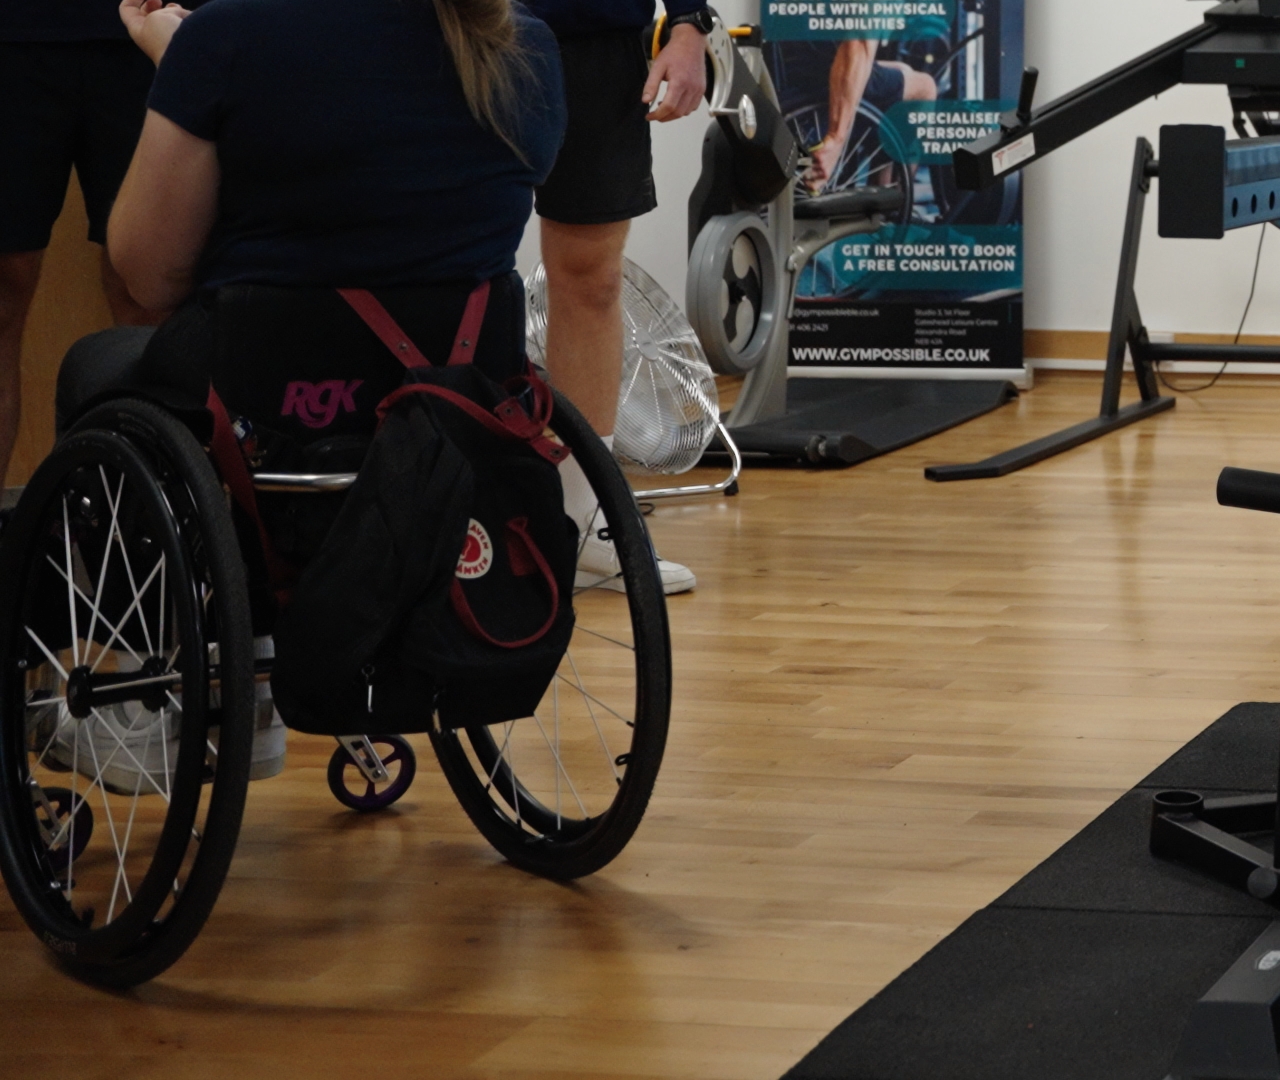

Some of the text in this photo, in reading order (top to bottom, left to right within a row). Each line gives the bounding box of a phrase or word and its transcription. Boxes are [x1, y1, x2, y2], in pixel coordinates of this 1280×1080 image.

[769, 3, 946, 15] PEOPLE WITH PHYSICAL
[809, 18, 905, 30] DISABILITIES
[842, 245, 1016, 257] GET IN TOUCH TO BOOK
[844, 260, 1015, 271] A FREE CONSULTATION
[949, 328, 966, 336] Road
[792, 348, 990, 362] WWW.GYMPOSSIBLE.CO.UK
